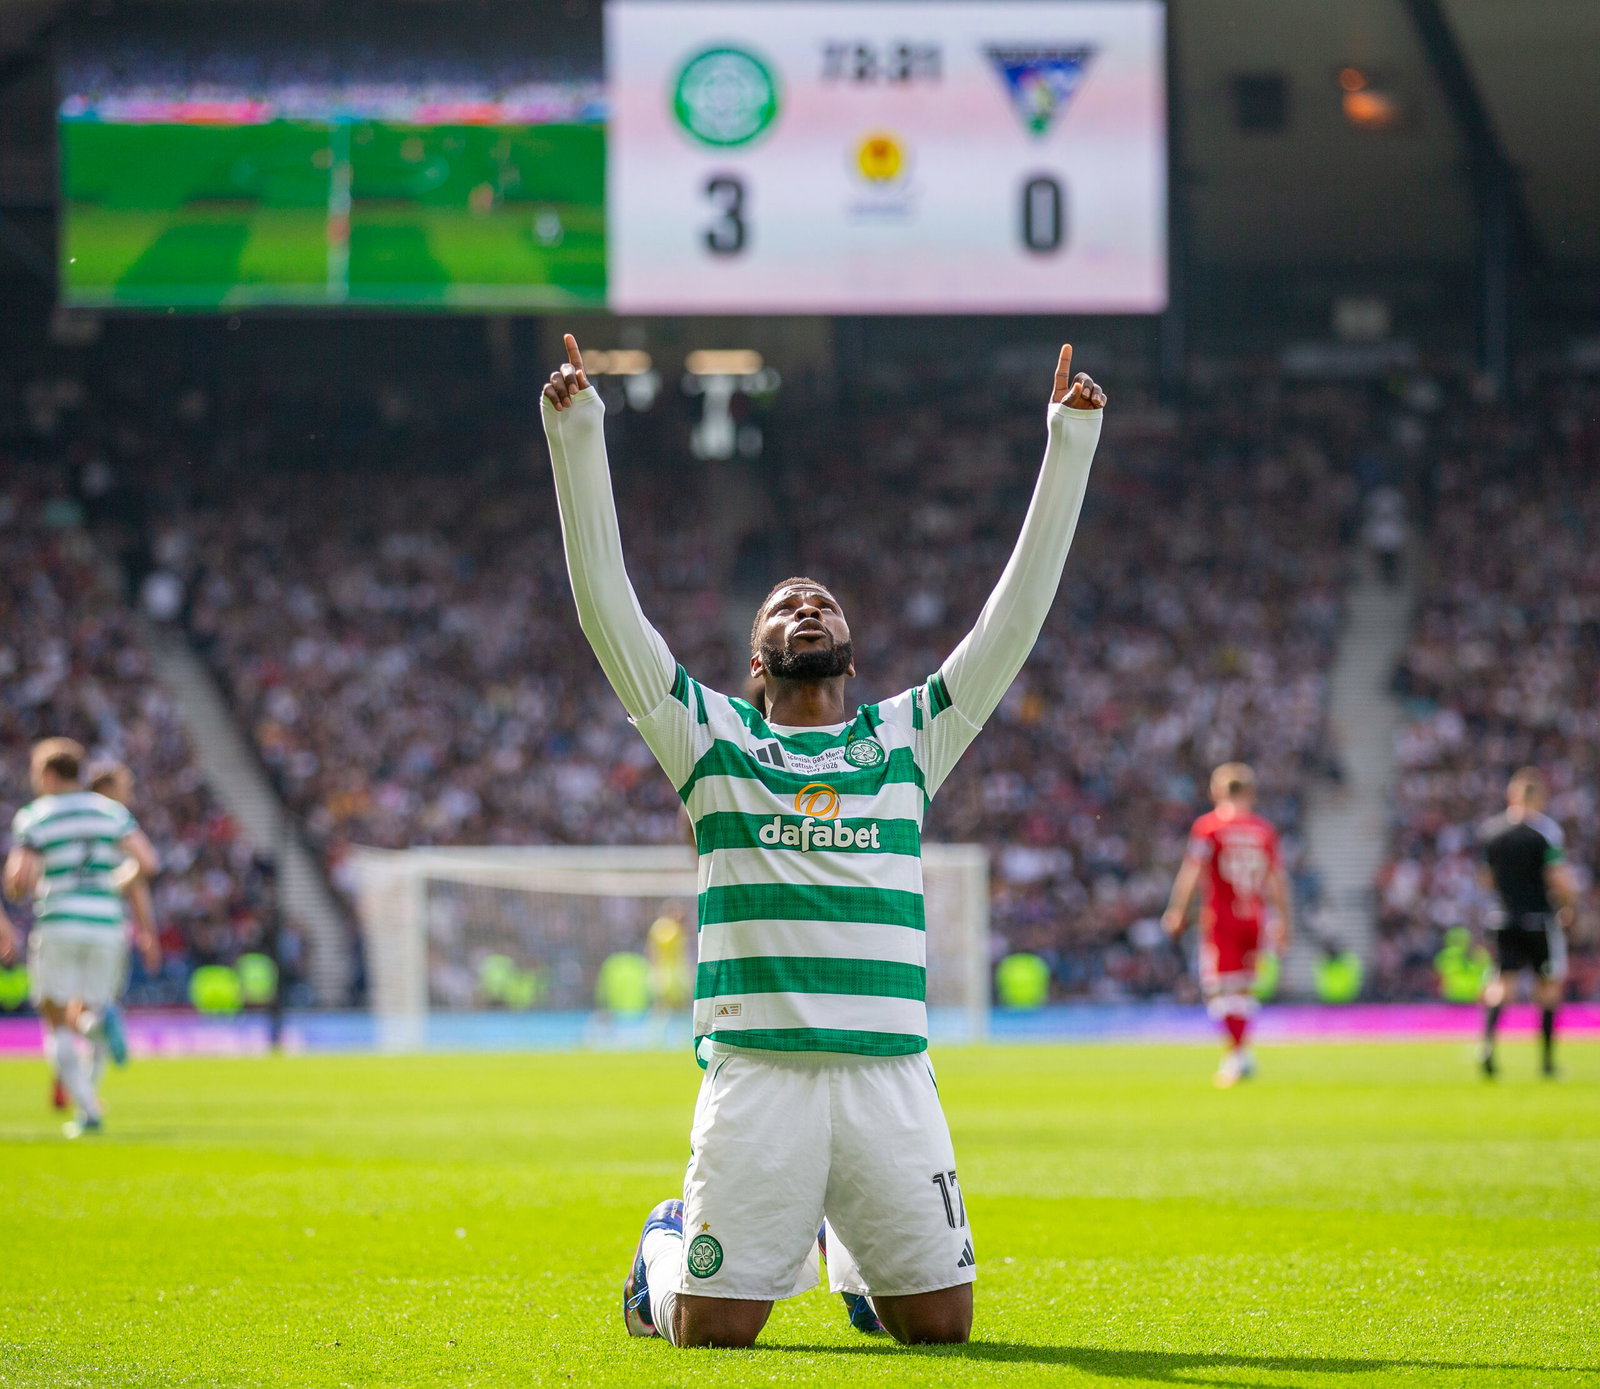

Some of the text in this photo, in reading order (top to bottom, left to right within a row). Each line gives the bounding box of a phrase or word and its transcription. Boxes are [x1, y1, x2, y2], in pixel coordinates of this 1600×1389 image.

[705, 176, 747, 255] 3
[1020, 177, 1064, 254] 0
[791, 761, 814, 770] cottish
[812, 755, 825, 764] Gas
[822, 762, 838, 770] 2026
[758, 815, 881, 853] dafabet
[932, 1170, 965, 1229] 17
